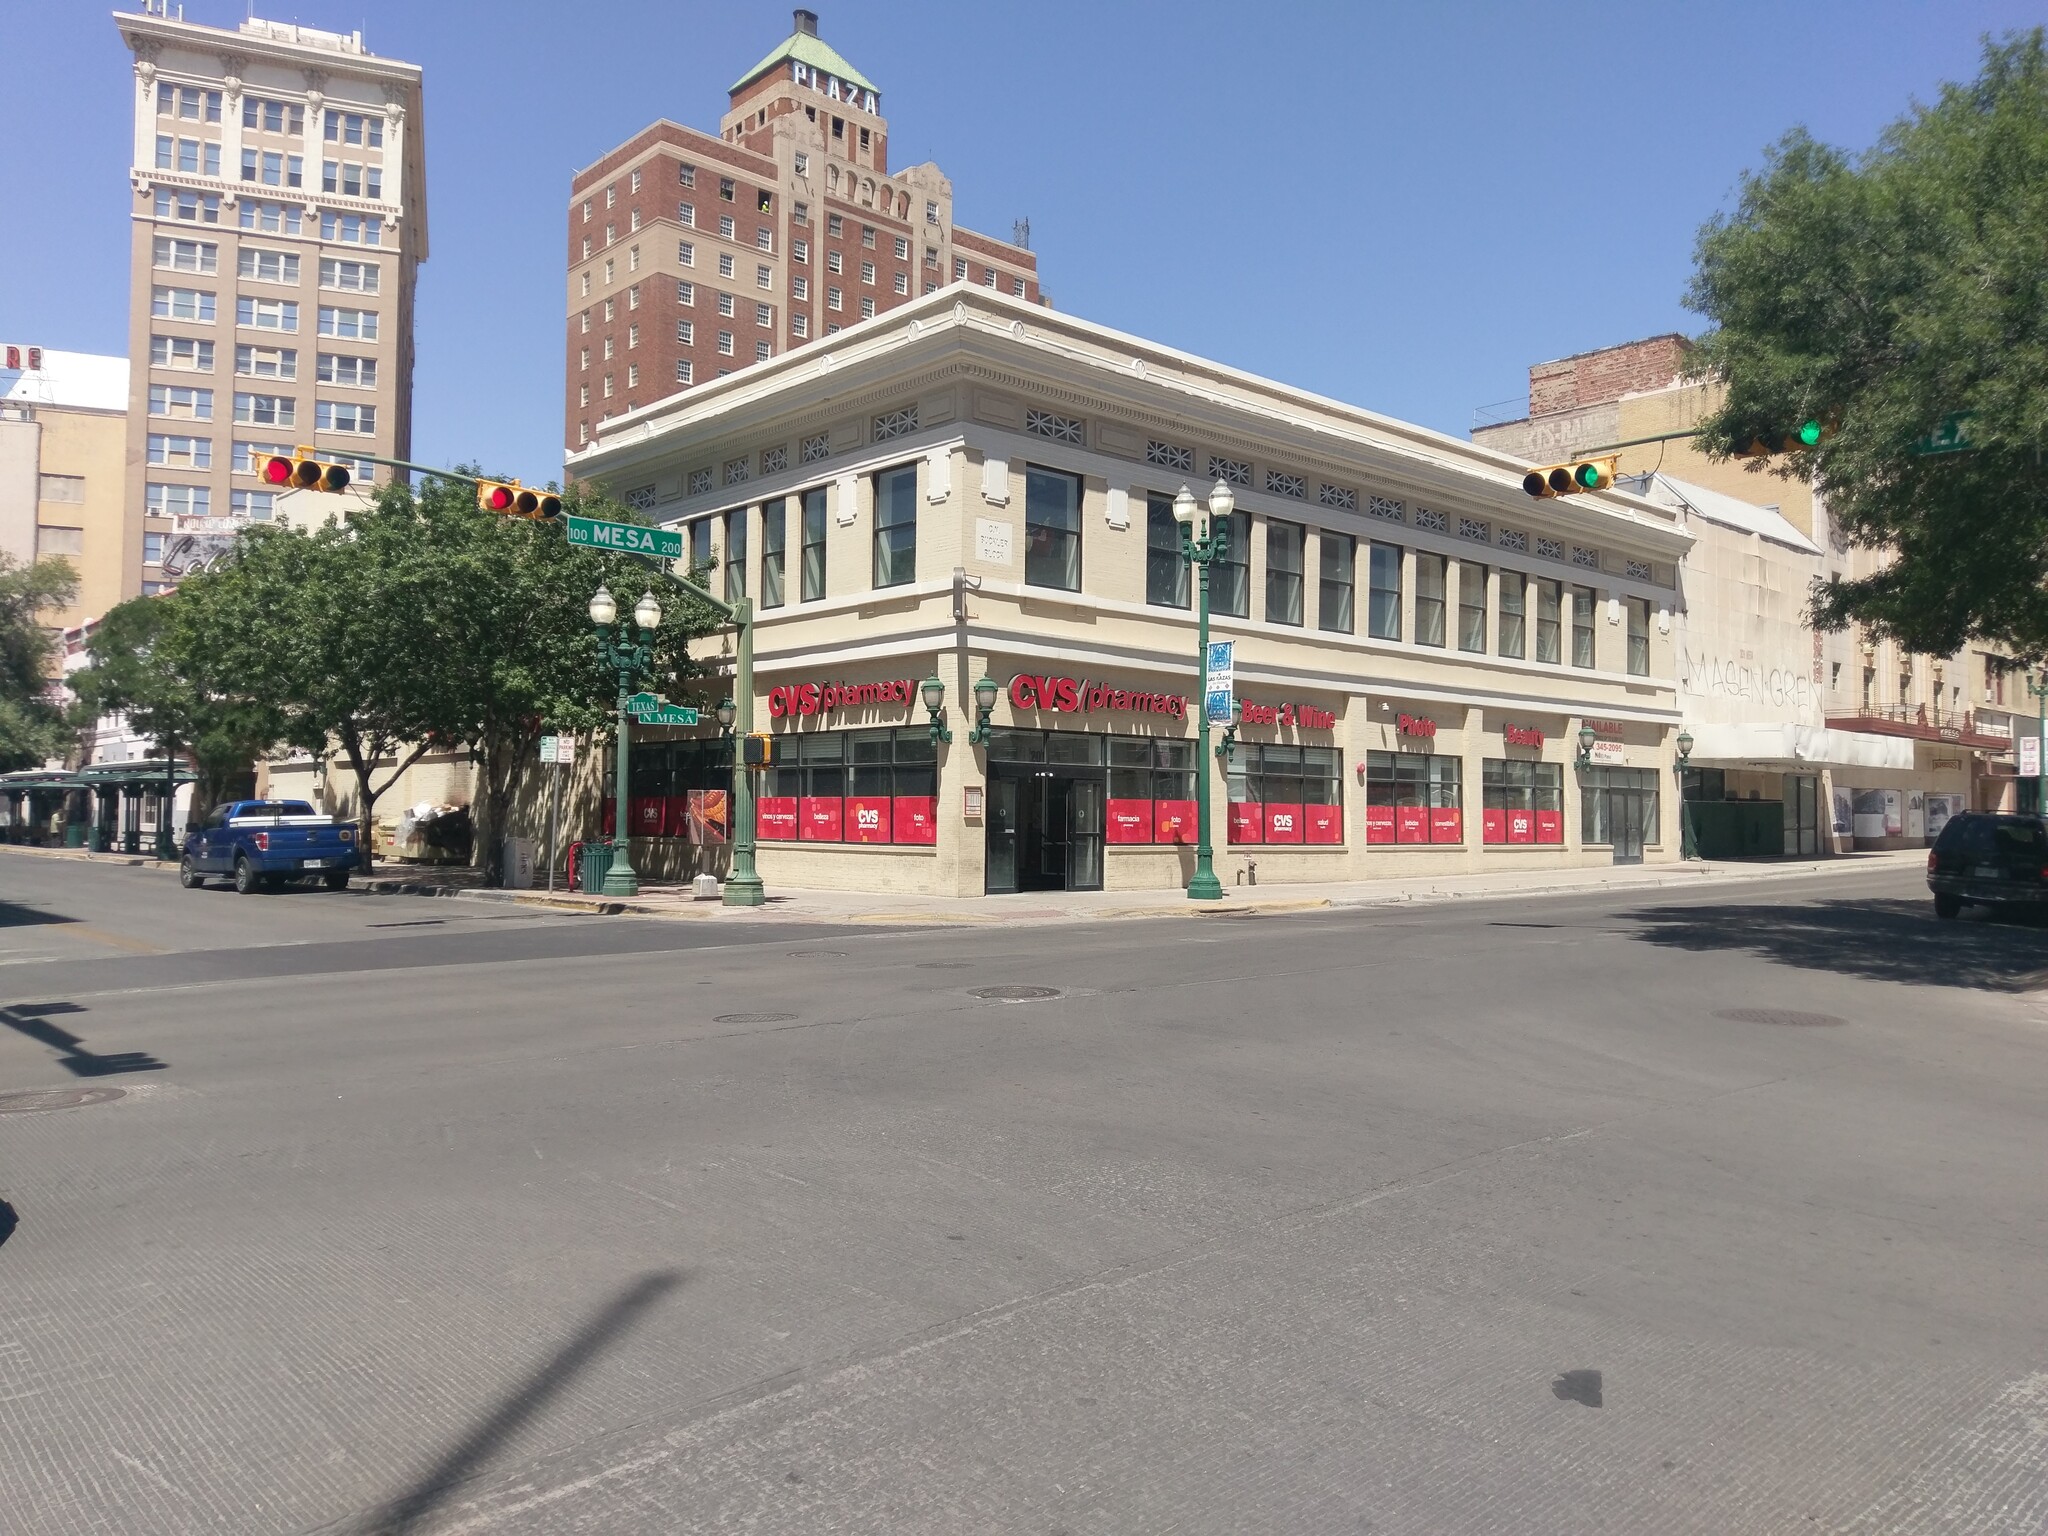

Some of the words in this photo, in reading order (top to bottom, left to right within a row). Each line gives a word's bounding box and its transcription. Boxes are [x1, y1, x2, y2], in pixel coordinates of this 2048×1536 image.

[793, 61, 876, 115] PLAZA
[570, 528, 587, 541] 100
[593, 525, 655, 551] MESA
[661, 541, 681, 554] 200
[632, 702, 655, 711] TEXAS
[768, 679, 914, 718] CVS/pharmacy
[1010, 673, 1189, 720] CVS/pharmacy
[643, 713, 652, 722] N
[656, 713, 693, 723] MESA
[1242, 699, 1279, 724] Beer
[1282, 703, 1295, 726] &
[1298, 705, 1335, 729] Wine
[1399, 714, 1437, 736] Photo
[1507, 723, 1545, 750] Beauty
[858, 809, 879, 824] CVS
[1273, 814, 1293, 827] CVS
[1513, 818, 1528, 829] CVS
